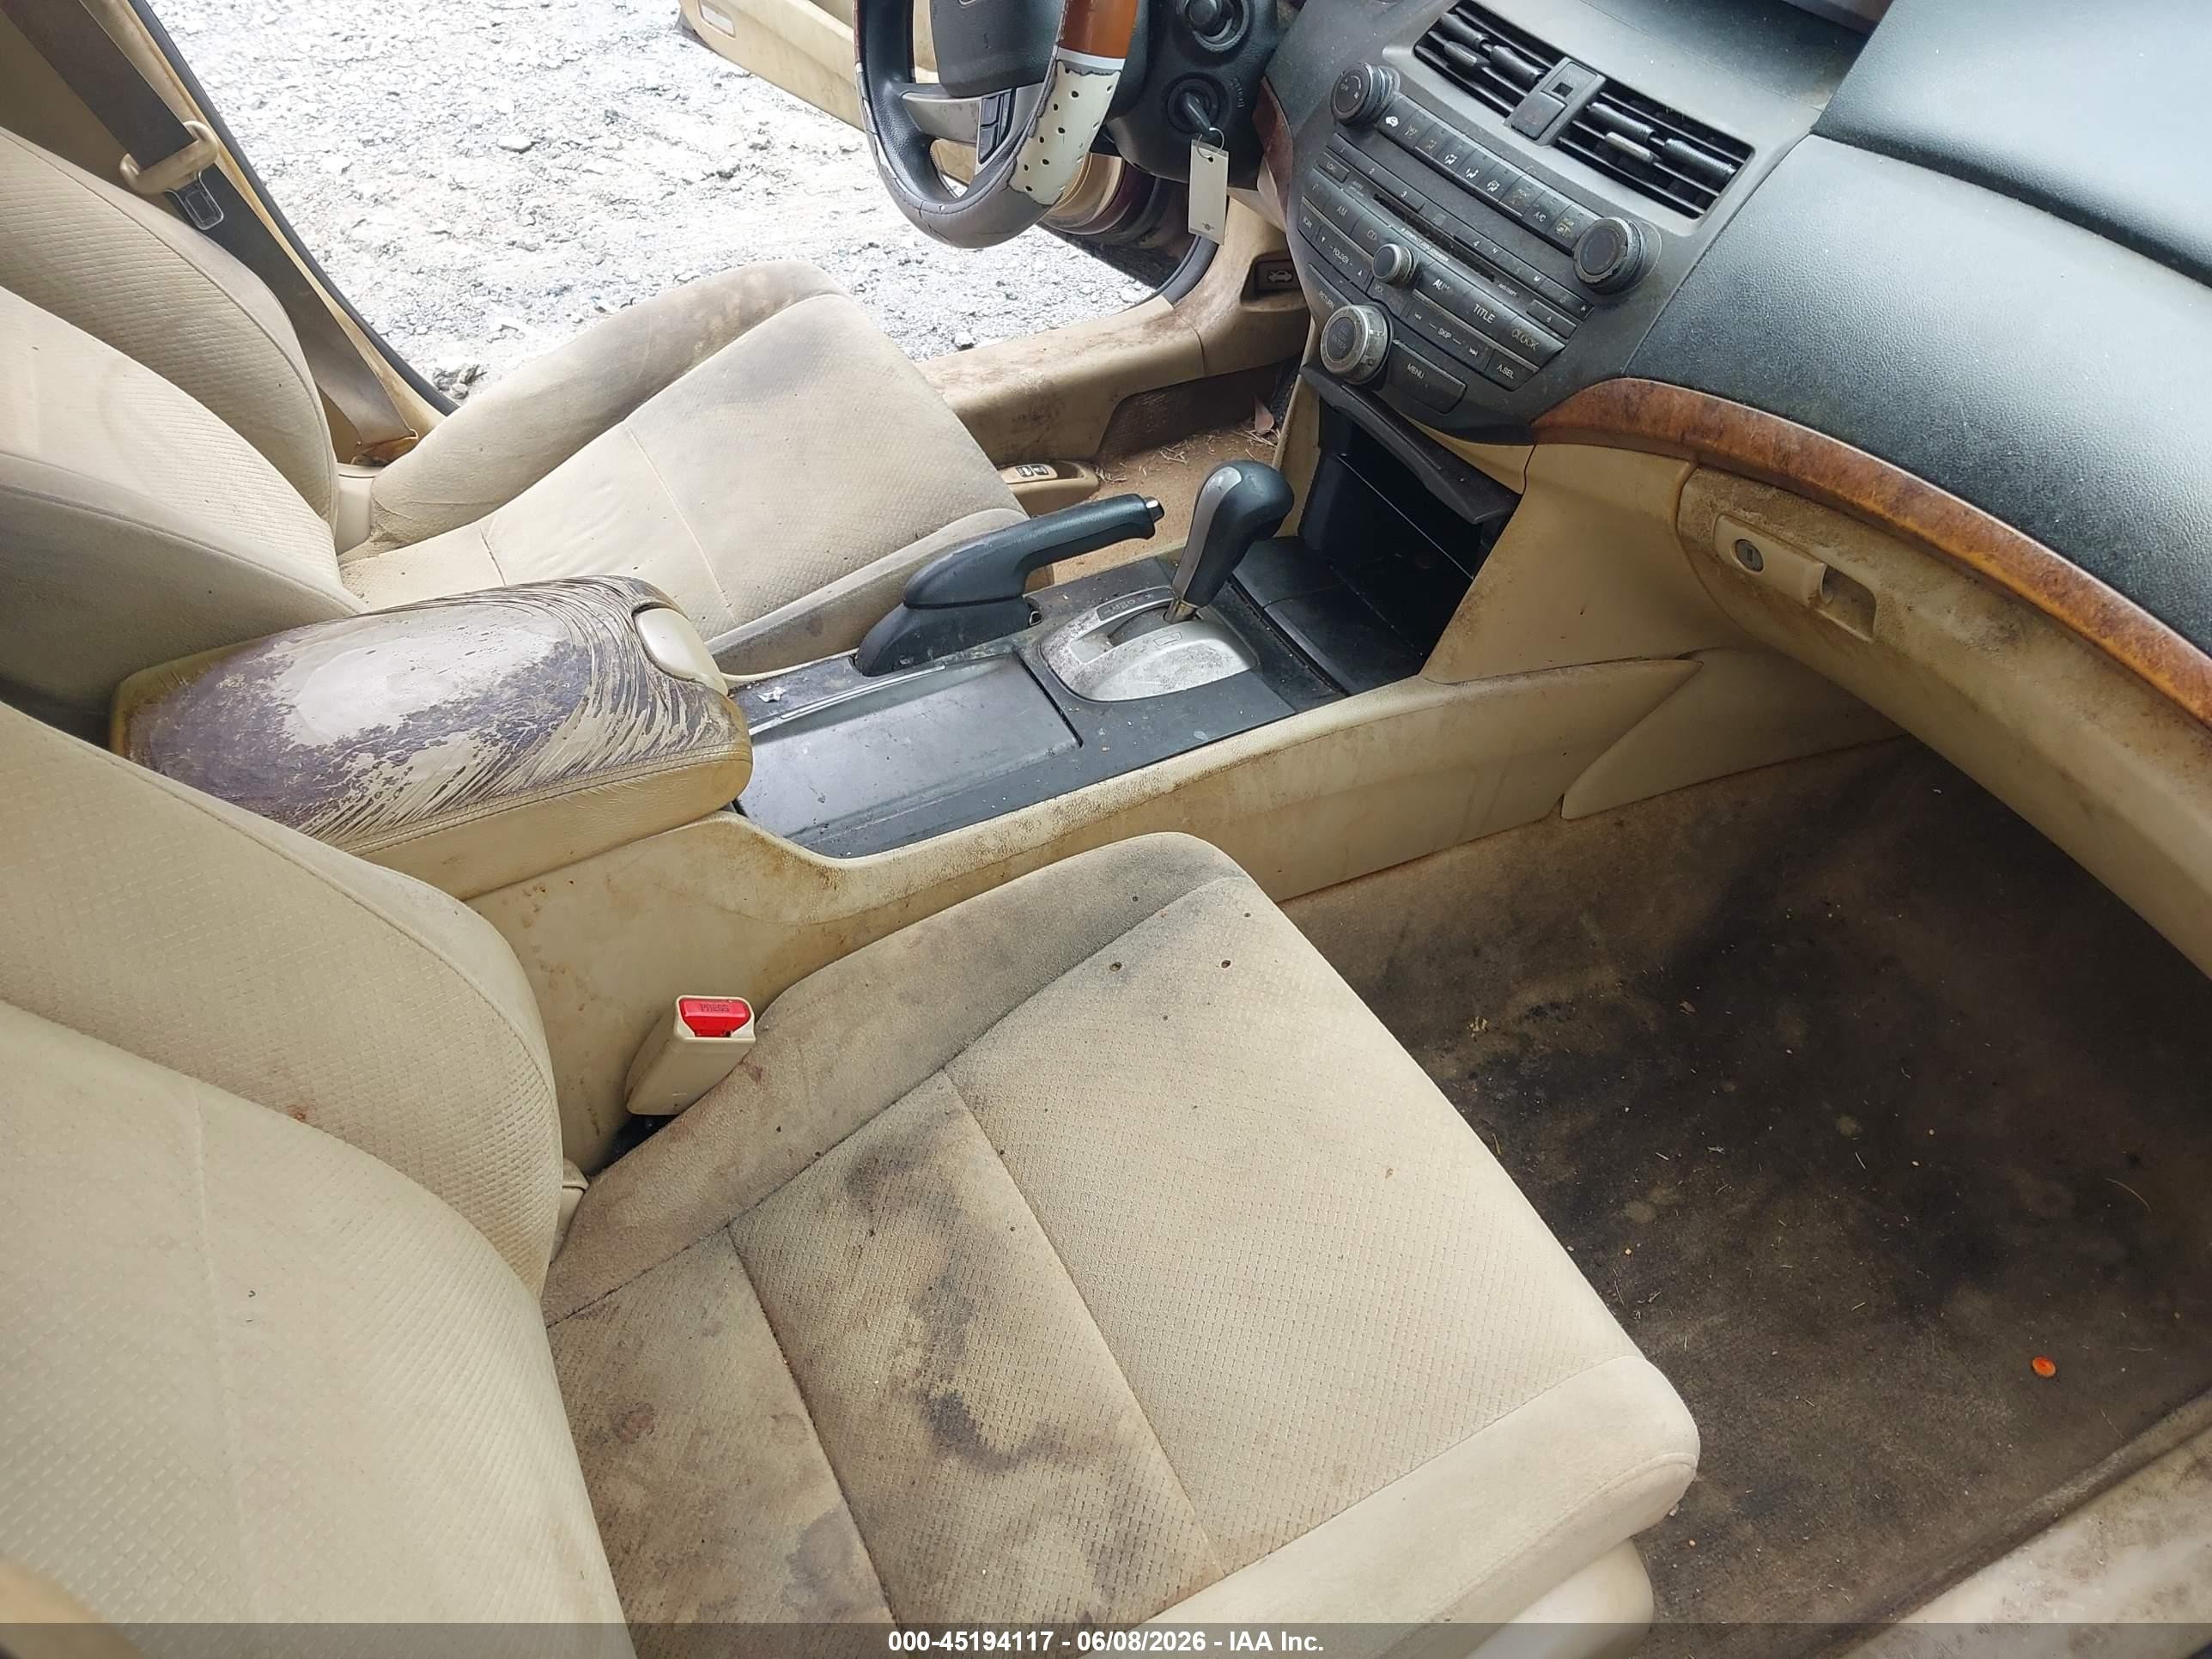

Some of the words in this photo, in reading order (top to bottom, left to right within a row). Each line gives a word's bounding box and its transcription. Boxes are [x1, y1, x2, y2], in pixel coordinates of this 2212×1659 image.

[1336, 205, 1348, 218] AM
[1533, 211, 1547, 222] A/C
[1333, 247, 1349, 263] FOLDER
[1473, 303, 1496, 324] TITLE
[1437, 327, 1452, 339] SKIP
[1511, 329, 1539, 350] CLOCK
[1407, 362, 1425, 379] MENU
